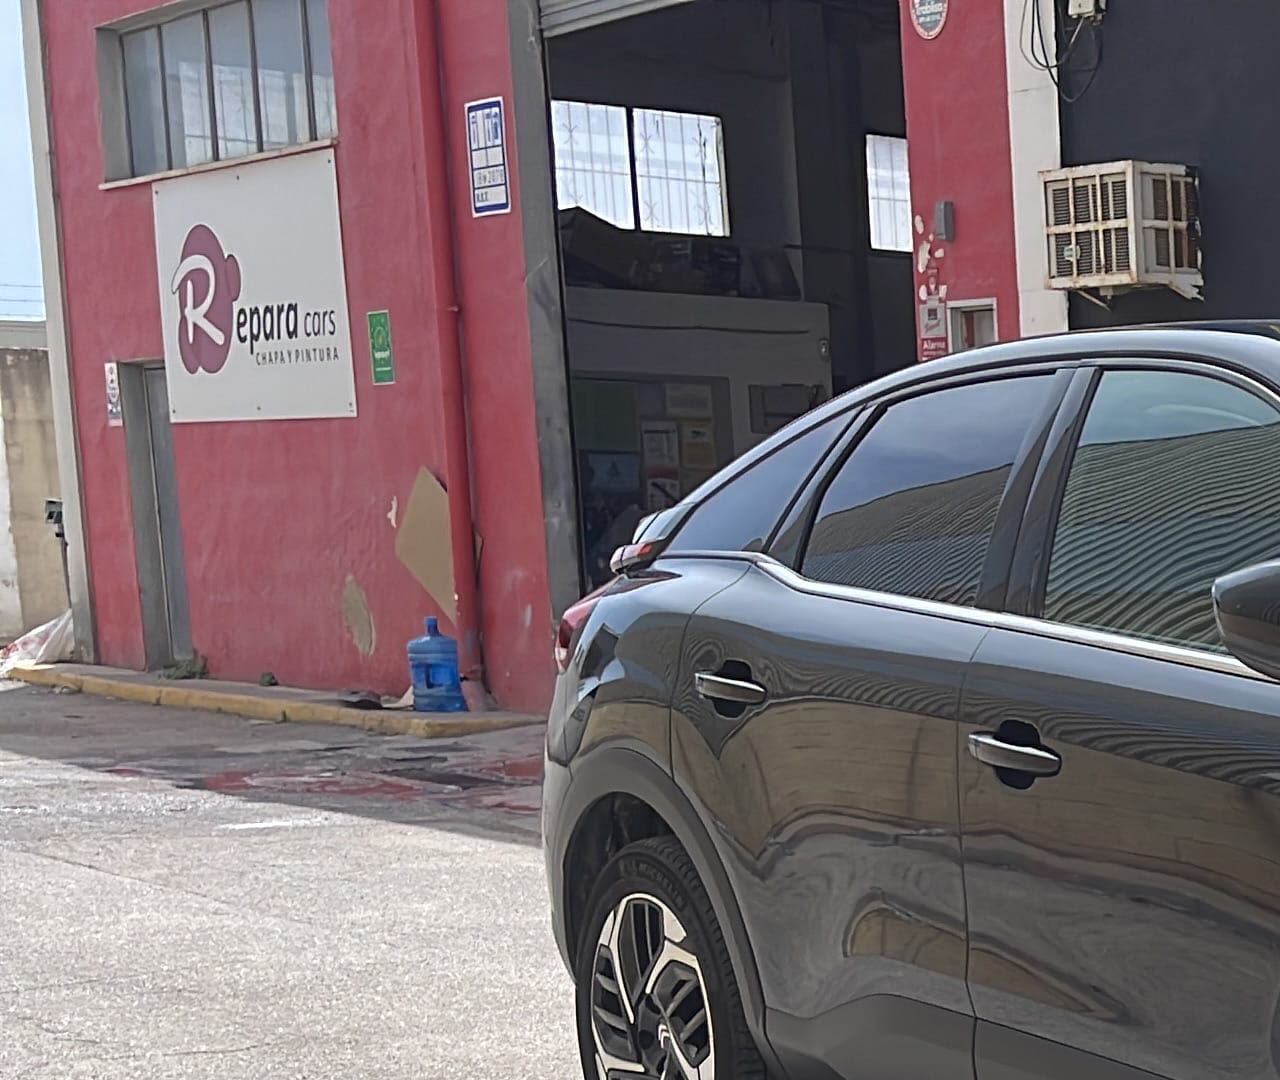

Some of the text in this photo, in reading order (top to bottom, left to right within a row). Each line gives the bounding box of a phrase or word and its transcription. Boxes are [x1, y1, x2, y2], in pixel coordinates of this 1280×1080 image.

[171, 254, 336, 355] Repara cars
[256, 347, 340, 366] CHAPA Y PINTURA
